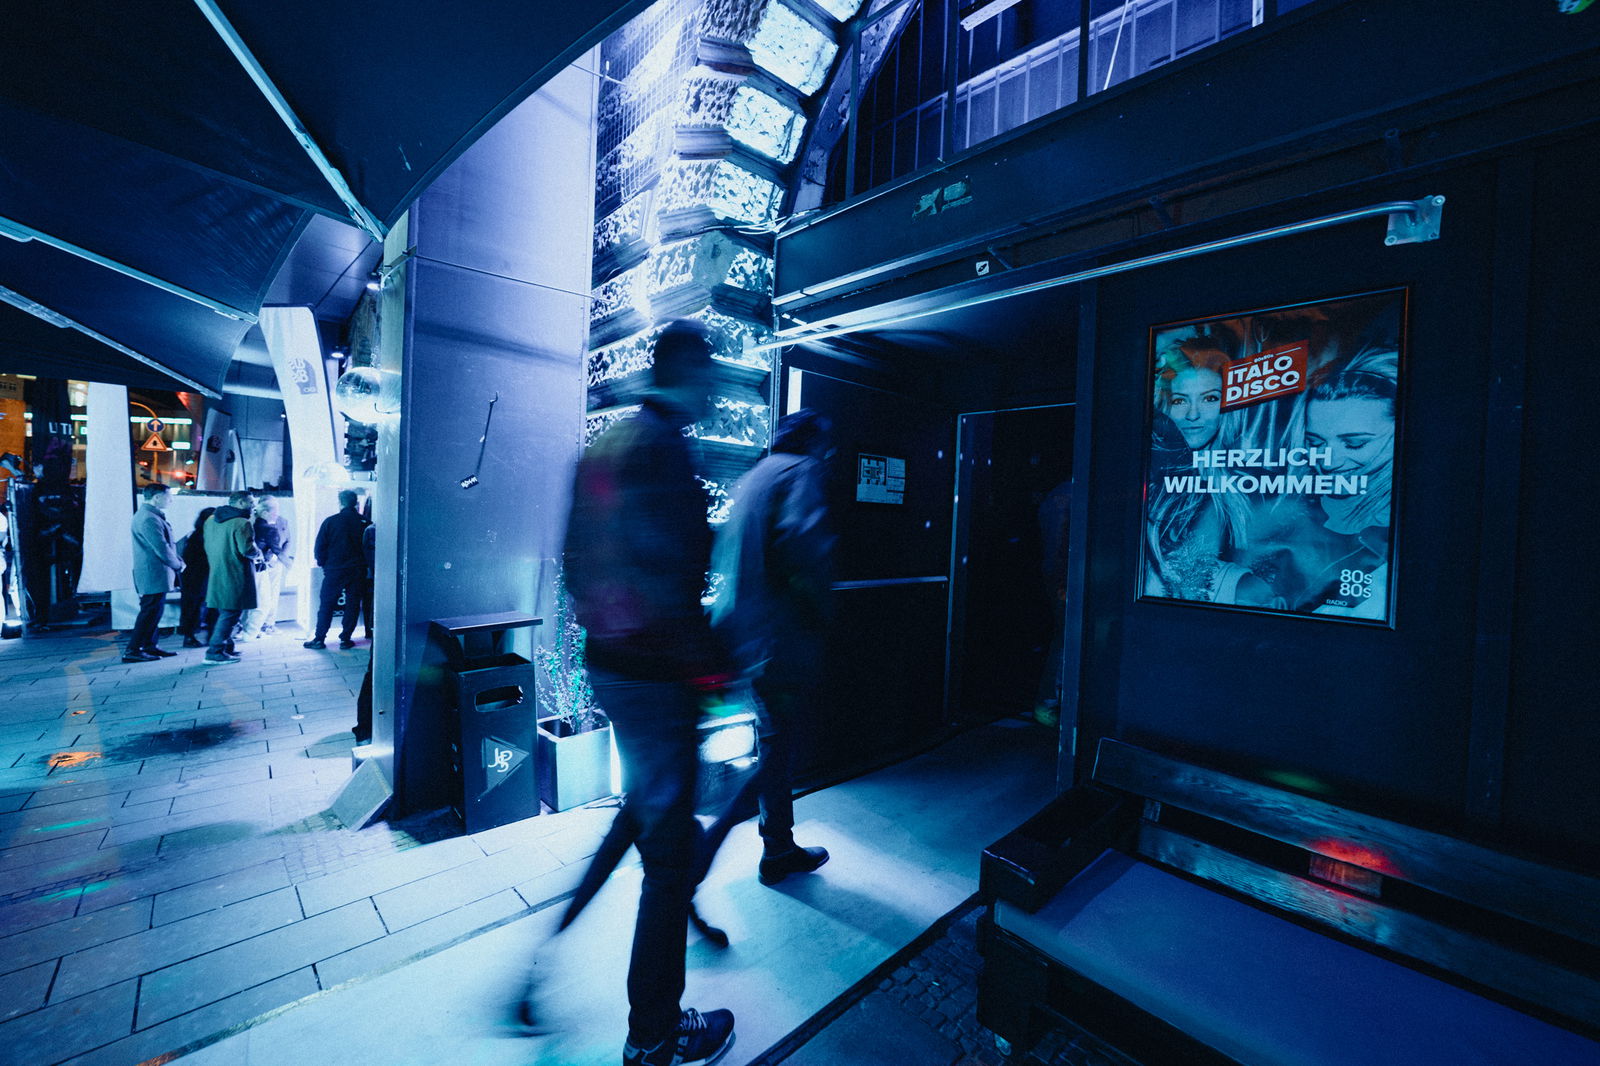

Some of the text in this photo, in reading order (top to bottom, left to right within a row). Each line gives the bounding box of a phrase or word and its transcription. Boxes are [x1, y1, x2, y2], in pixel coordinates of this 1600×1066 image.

[1227, 355, 1294, 386] ITALO
[1225, 370, 1301, 403] DISCO
[1192, 446, 1333, 469] HERZLICH
[1163, 474, 1369, 496] WILLKOMMEN!
[1340, 568, 1373, 585] 80s
[1339, 582, 1372, 598] 80s
